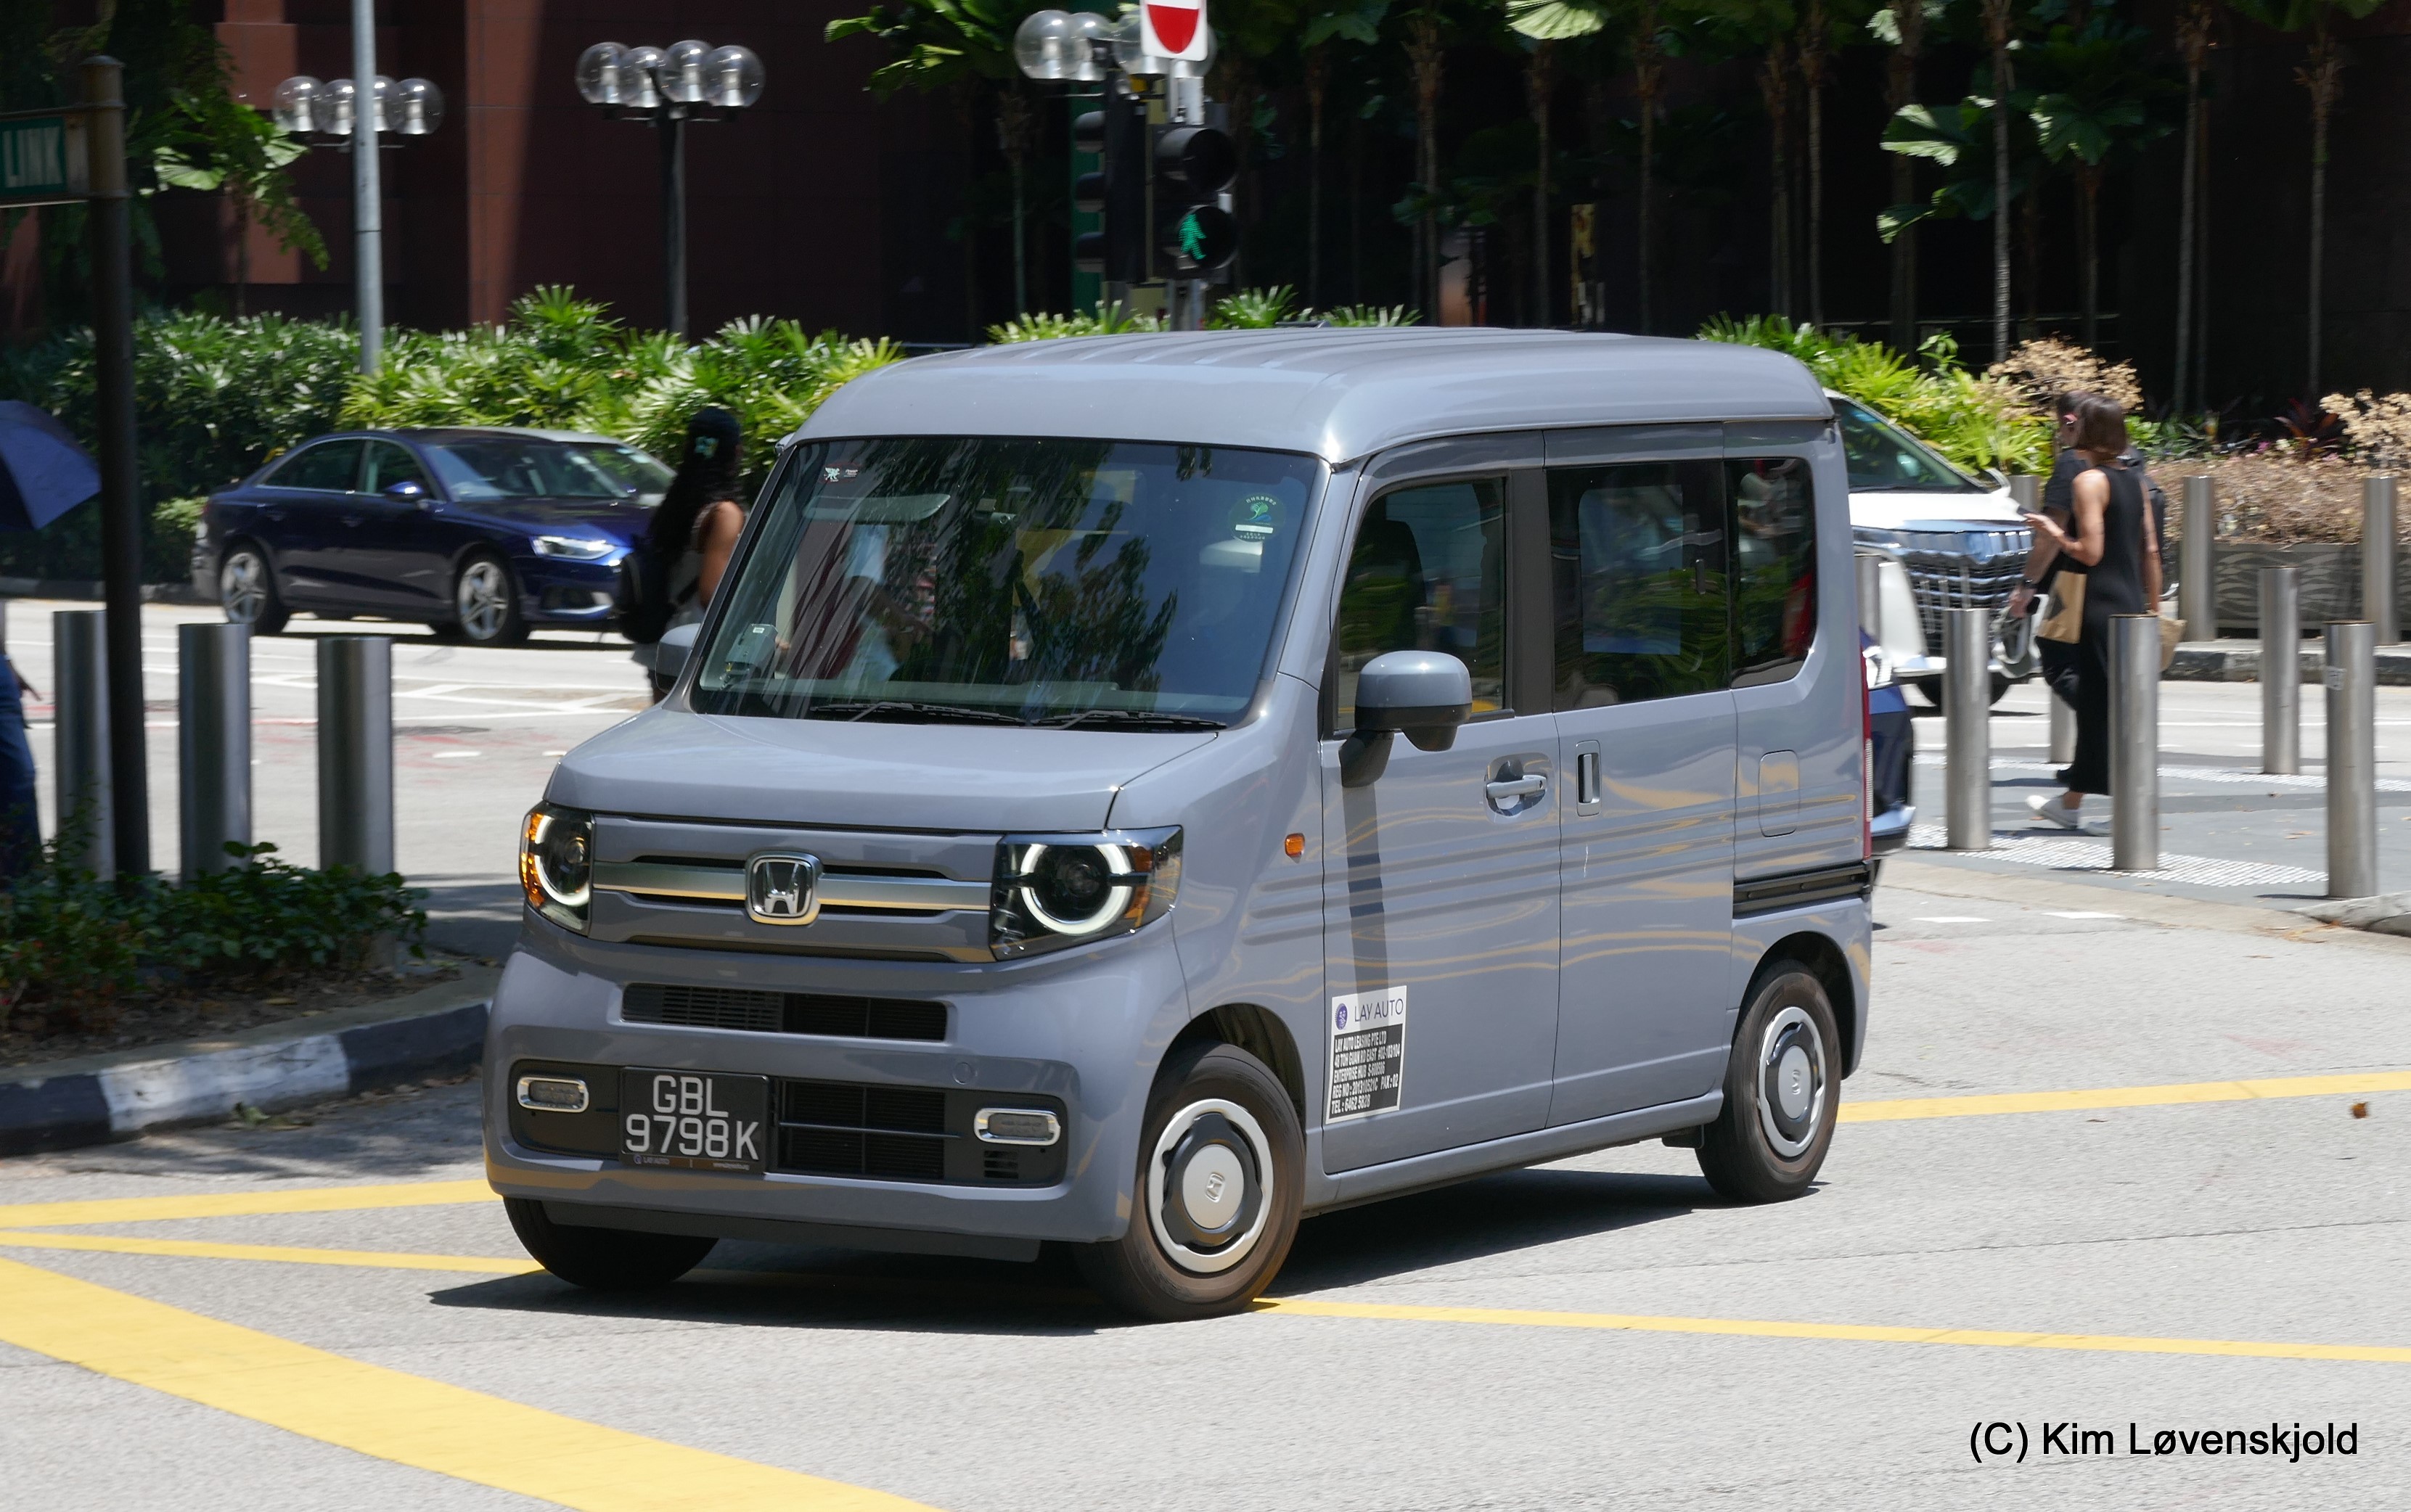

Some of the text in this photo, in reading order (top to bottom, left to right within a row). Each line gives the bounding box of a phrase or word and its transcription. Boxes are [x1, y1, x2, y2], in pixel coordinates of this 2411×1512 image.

[1354, 998, 1404, 1022] LAY AUTO
[1367, 1048, 1377, 1062] EAST
[653, 1075, 729, 1118] GBL
[1332, 1100, 1340, 1114] TEL
